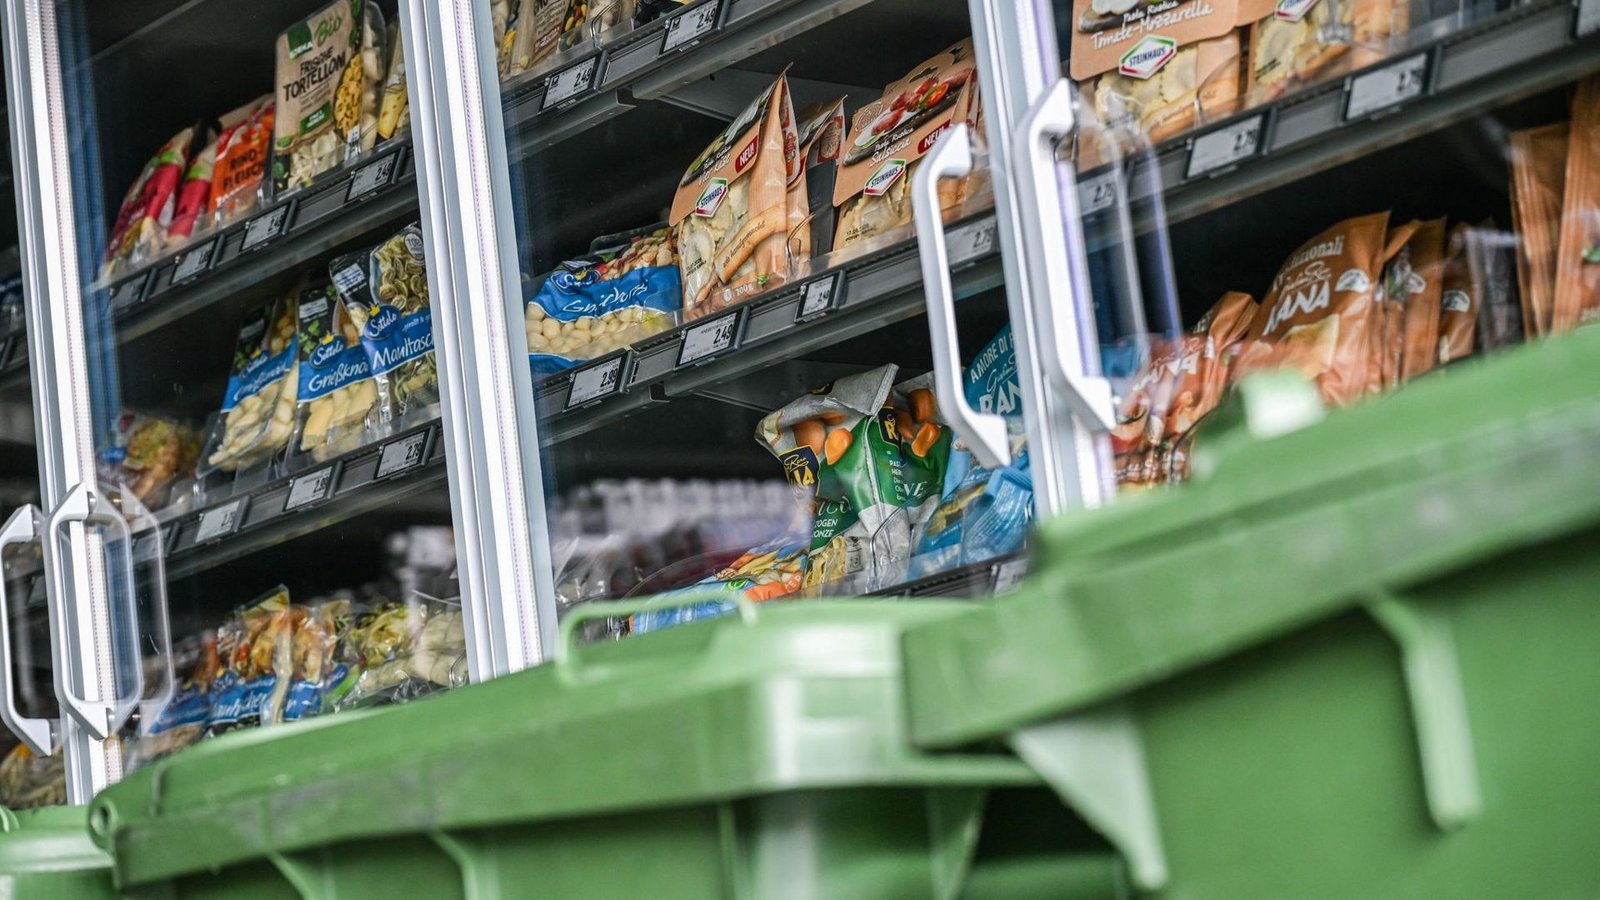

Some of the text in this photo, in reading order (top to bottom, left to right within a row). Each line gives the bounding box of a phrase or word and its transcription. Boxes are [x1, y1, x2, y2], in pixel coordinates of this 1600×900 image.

[696, 7, 716, 29] 2.49
[1129, 46, 1167, 67] STEINHAUS
[573, 67, 592, 88] 2.49
[739, 142, 755, 167] NEU!
[870, 166, 900, 188] STEINHAUS
[700, 184, 723, 209] STEINHAUS
[713, 323, 733, 345] 2.49
[970, 342, 999, 384] AMORE
[998, 335, 1009, 355] DI
